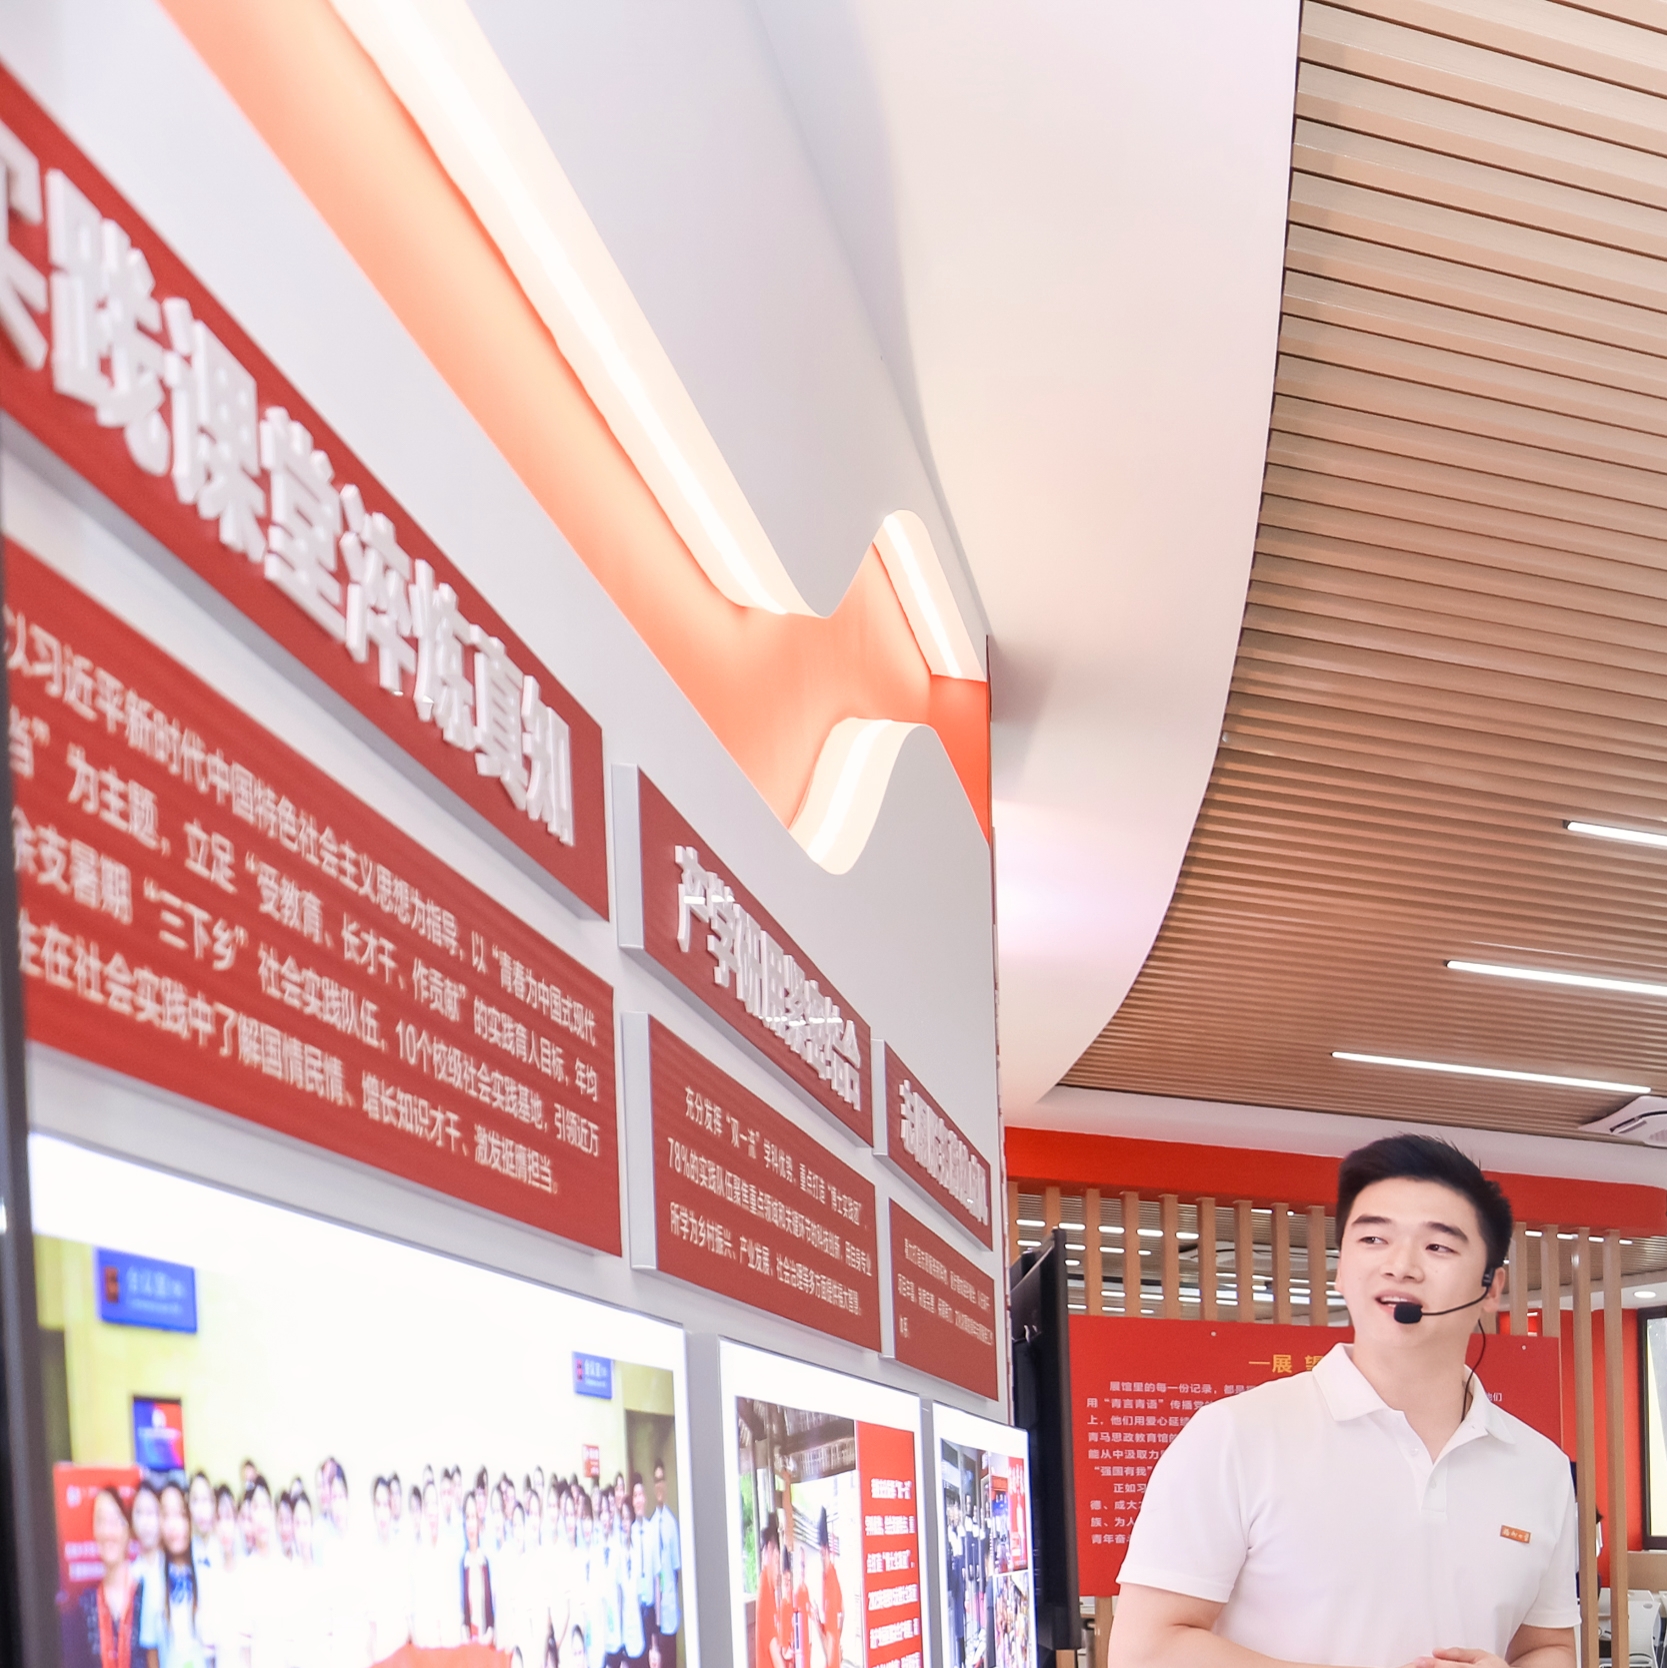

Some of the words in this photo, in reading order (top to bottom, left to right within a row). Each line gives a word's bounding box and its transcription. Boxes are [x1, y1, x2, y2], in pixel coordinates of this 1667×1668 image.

[1088, 1449, 1164, 1460] 能从中汲取力
[1091, 1534, 1131, 1545] 青年奋
